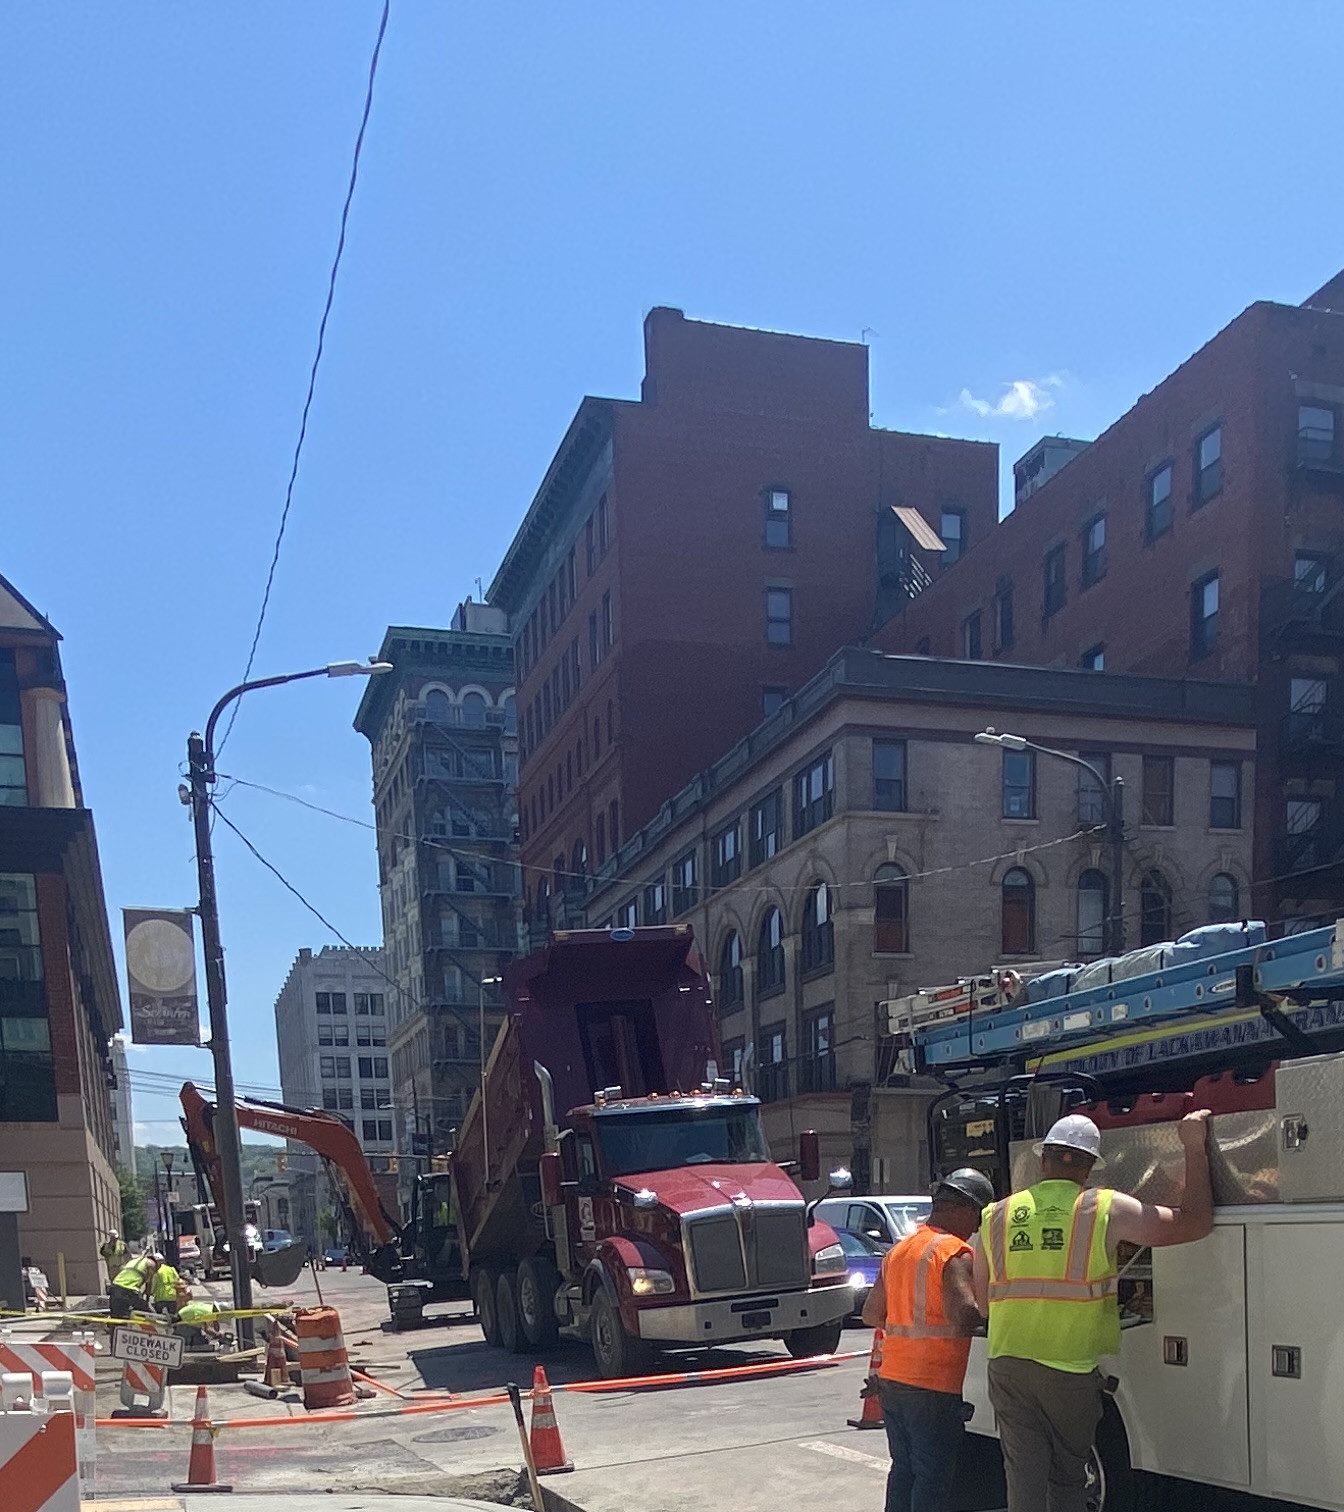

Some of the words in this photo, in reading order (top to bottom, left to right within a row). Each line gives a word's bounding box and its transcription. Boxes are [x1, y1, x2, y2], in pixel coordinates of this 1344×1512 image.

[253, 1119, 298, 1135] HITACHI
[121, 1334, 176, 1352] SIDEWALK
[126, 1346, 170, 1361] CLOSED
